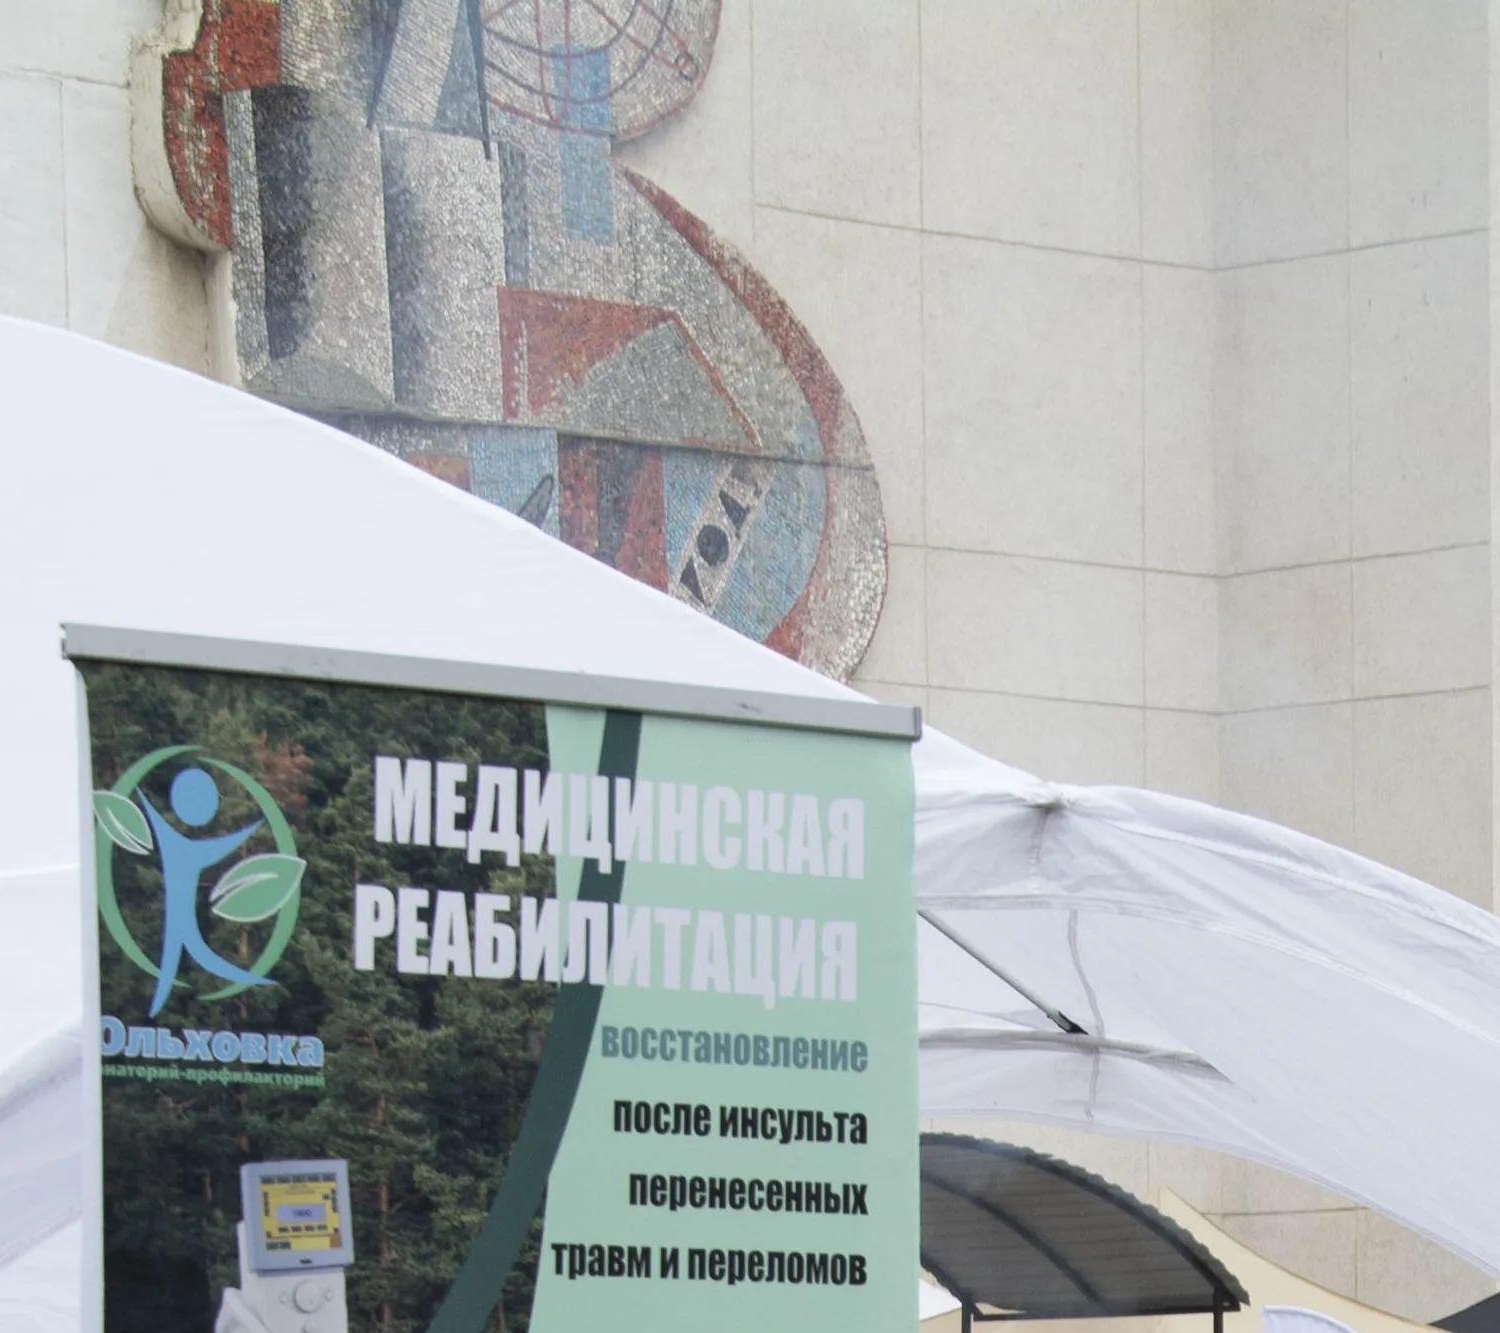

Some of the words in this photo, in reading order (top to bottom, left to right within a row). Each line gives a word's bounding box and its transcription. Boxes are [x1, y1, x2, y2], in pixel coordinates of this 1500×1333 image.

[373, 756, 866, 880] МЕДИЦИНСКАЯ
[354, 884, 858, 1009] РЕАБИЛИТАЦИЯ
[600, 1022, 869, 1074] восстановление
[613, 1100, 711, 1138] после
[719, 1104, 868, 1146] инсульта
[629, 1173, 868, 1217] перенесенных
[552, 1242, 651, 1280] травм
[661, 1245, 680, 1279] и
[688, 1248, 868, 1288] переломов
